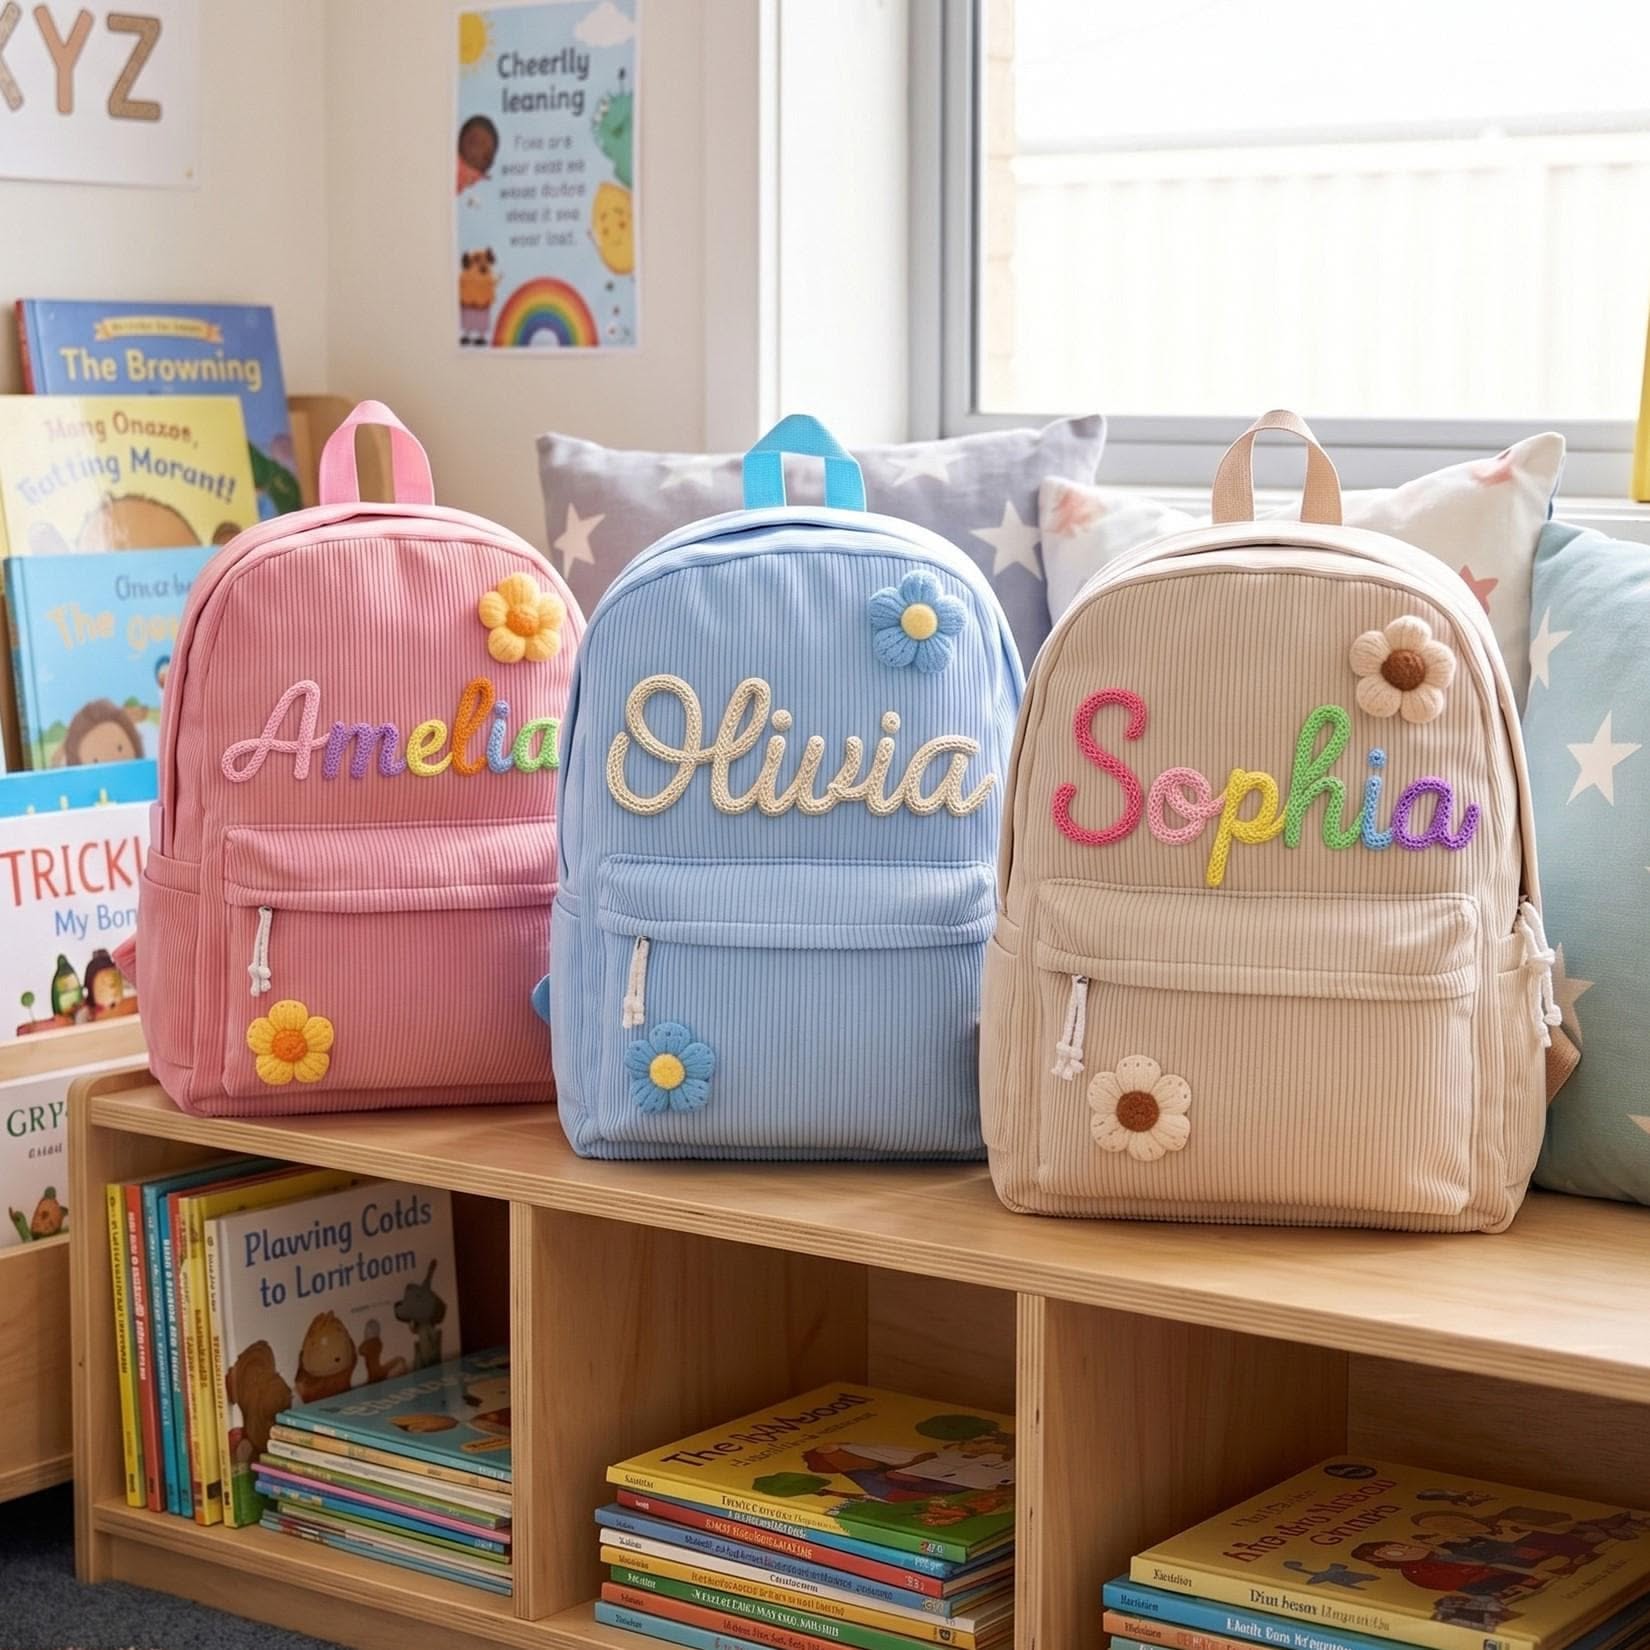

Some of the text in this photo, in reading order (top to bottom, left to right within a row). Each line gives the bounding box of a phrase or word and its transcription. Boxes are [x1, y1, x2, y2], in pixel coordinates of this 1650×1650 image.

[498, 47, 589, 80] Cheerlly
[502, 85, 585, 116] leaning
[60, 347, 262, 392] The Browning
[221, 676, 561, 783] Amelia
[606, 673, 997, 817] Olivia
[1052, 687, 1480, 888] Sophia
[55, 909, 88, 940] My
[7, 1101, 68, 1137] GRY
[260, 1277, 286, 1308] to
